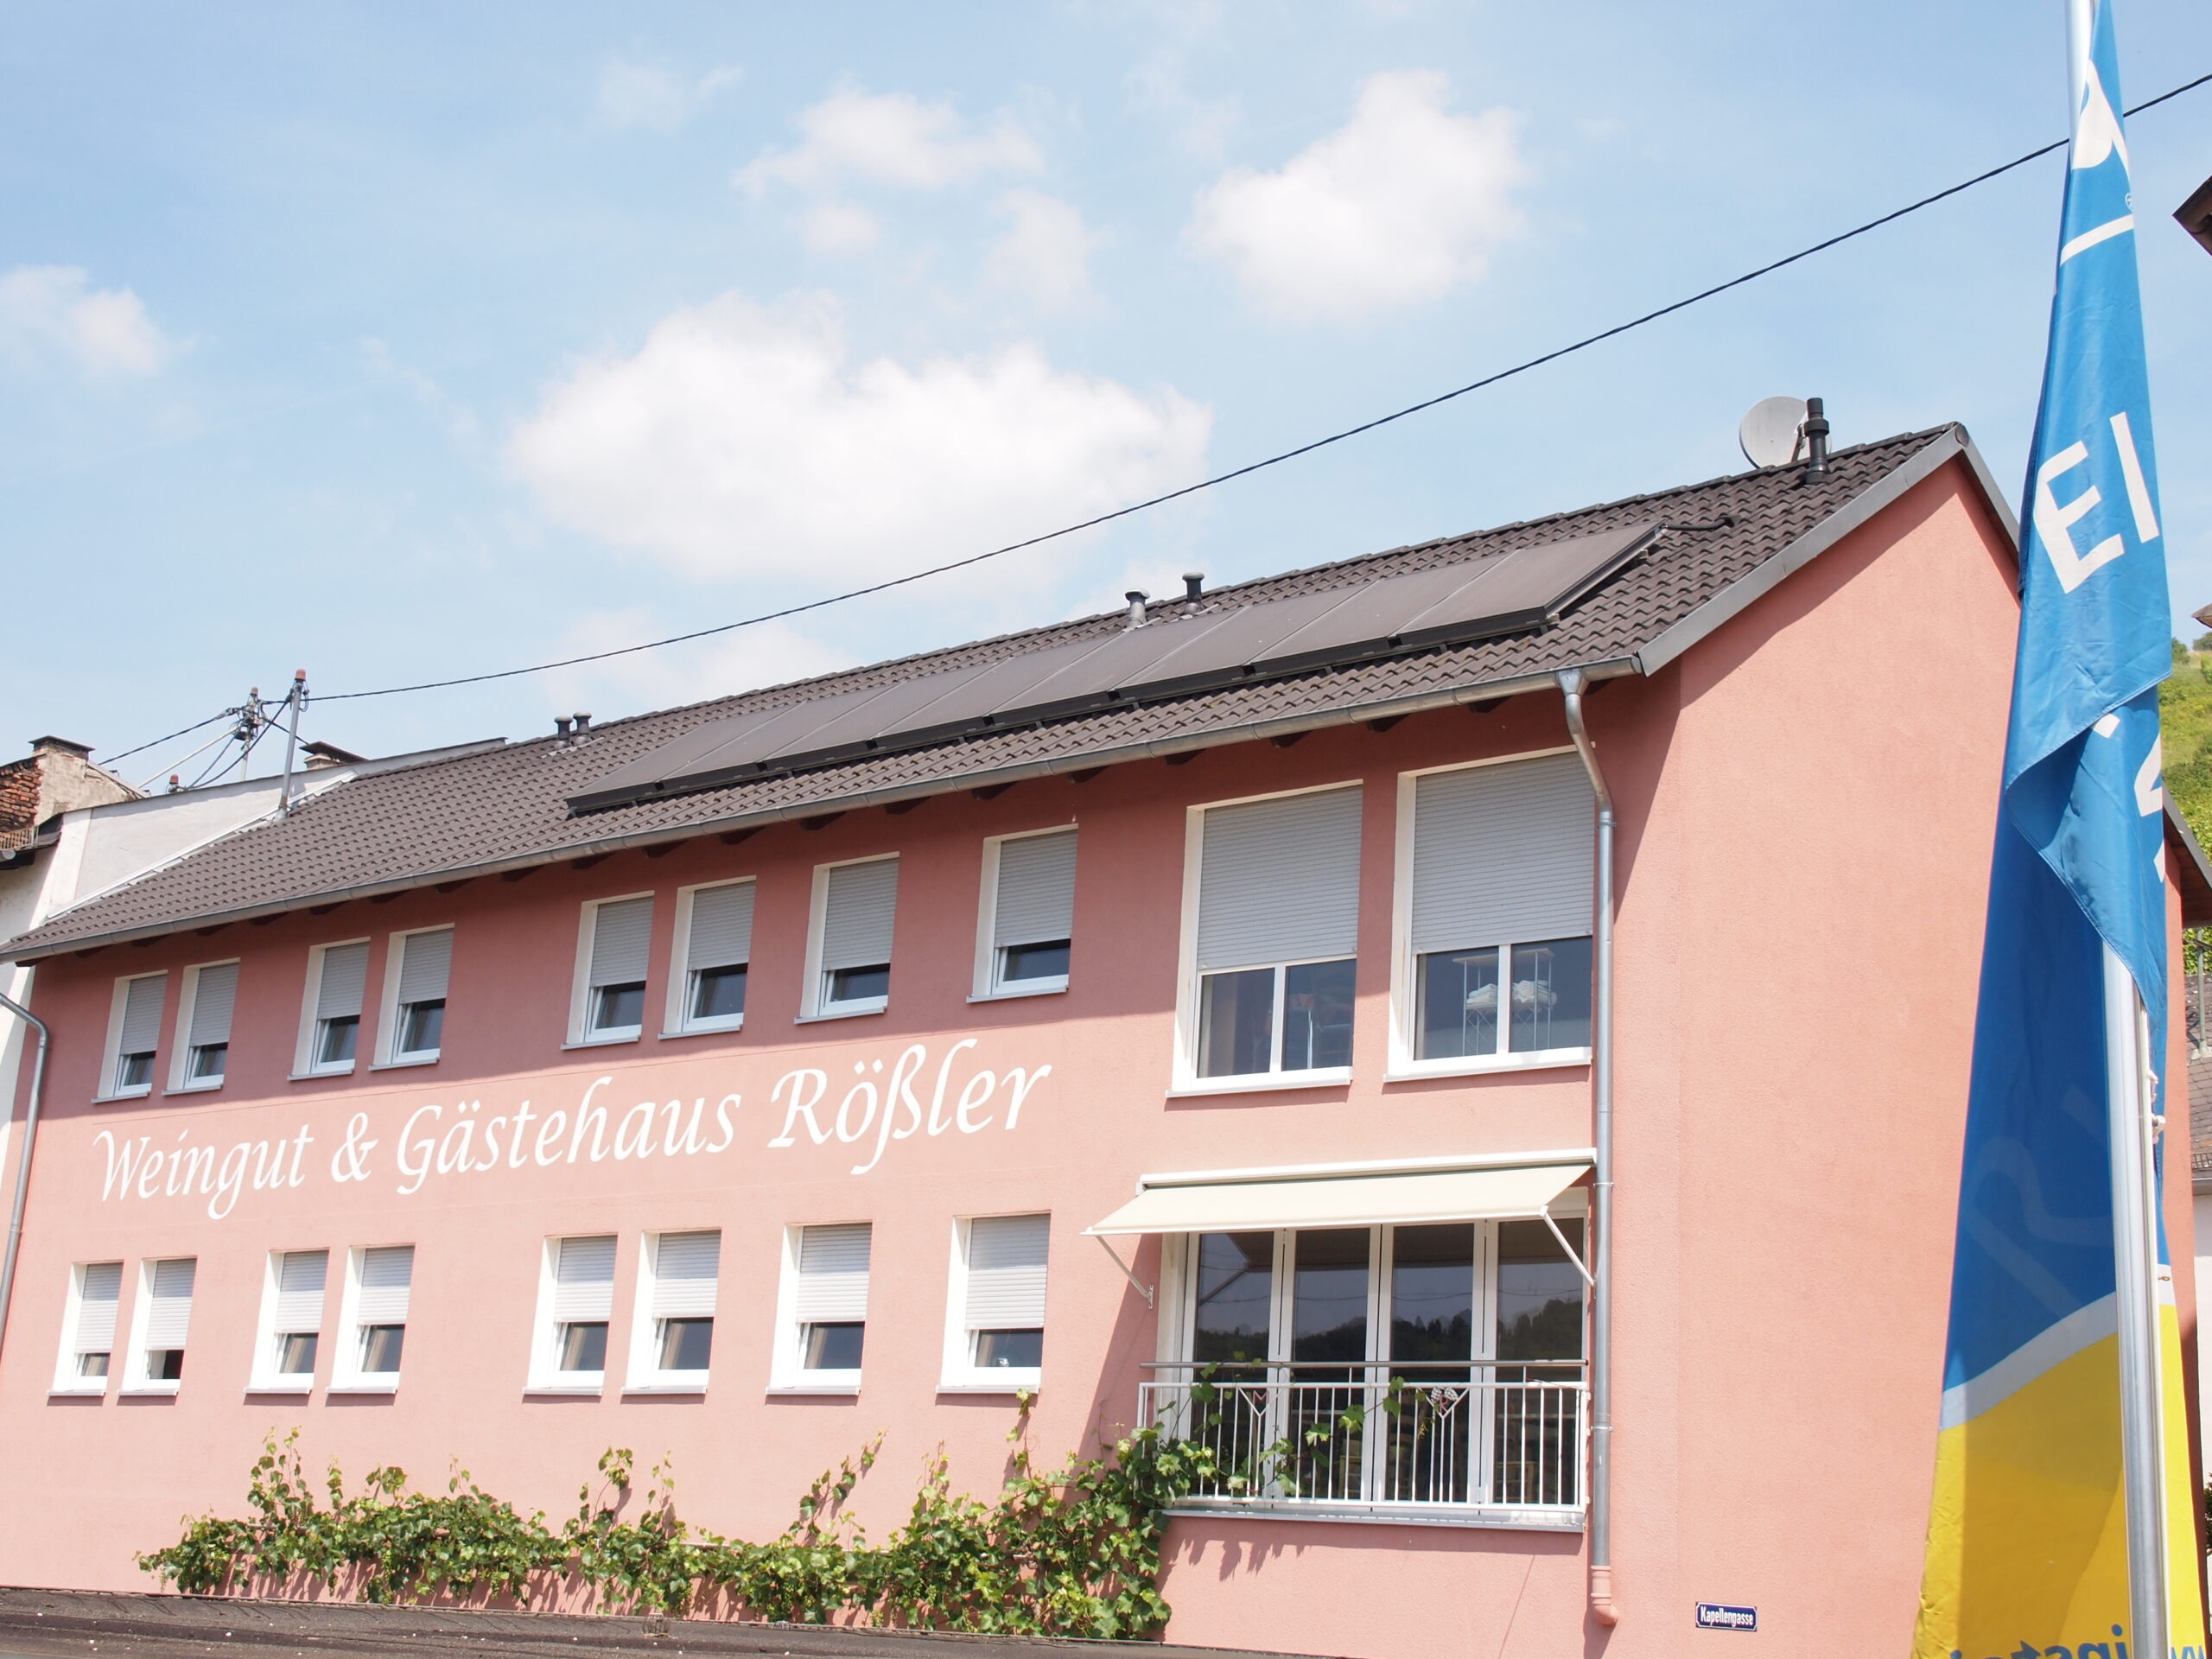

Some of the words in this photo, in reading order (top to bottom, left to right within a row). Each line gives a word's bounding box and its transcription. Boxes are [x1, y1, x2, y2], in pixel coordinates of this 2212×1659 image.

[92, 1124, 314, 1220] Weingut
[331, 1112, 378, 1183] &
[397, 1076, 741, 1195] Gästehaus
[767, 1039, 1052, 1175] Rößler
[1700, 1605, 1753, 1627] Kapellengasse
